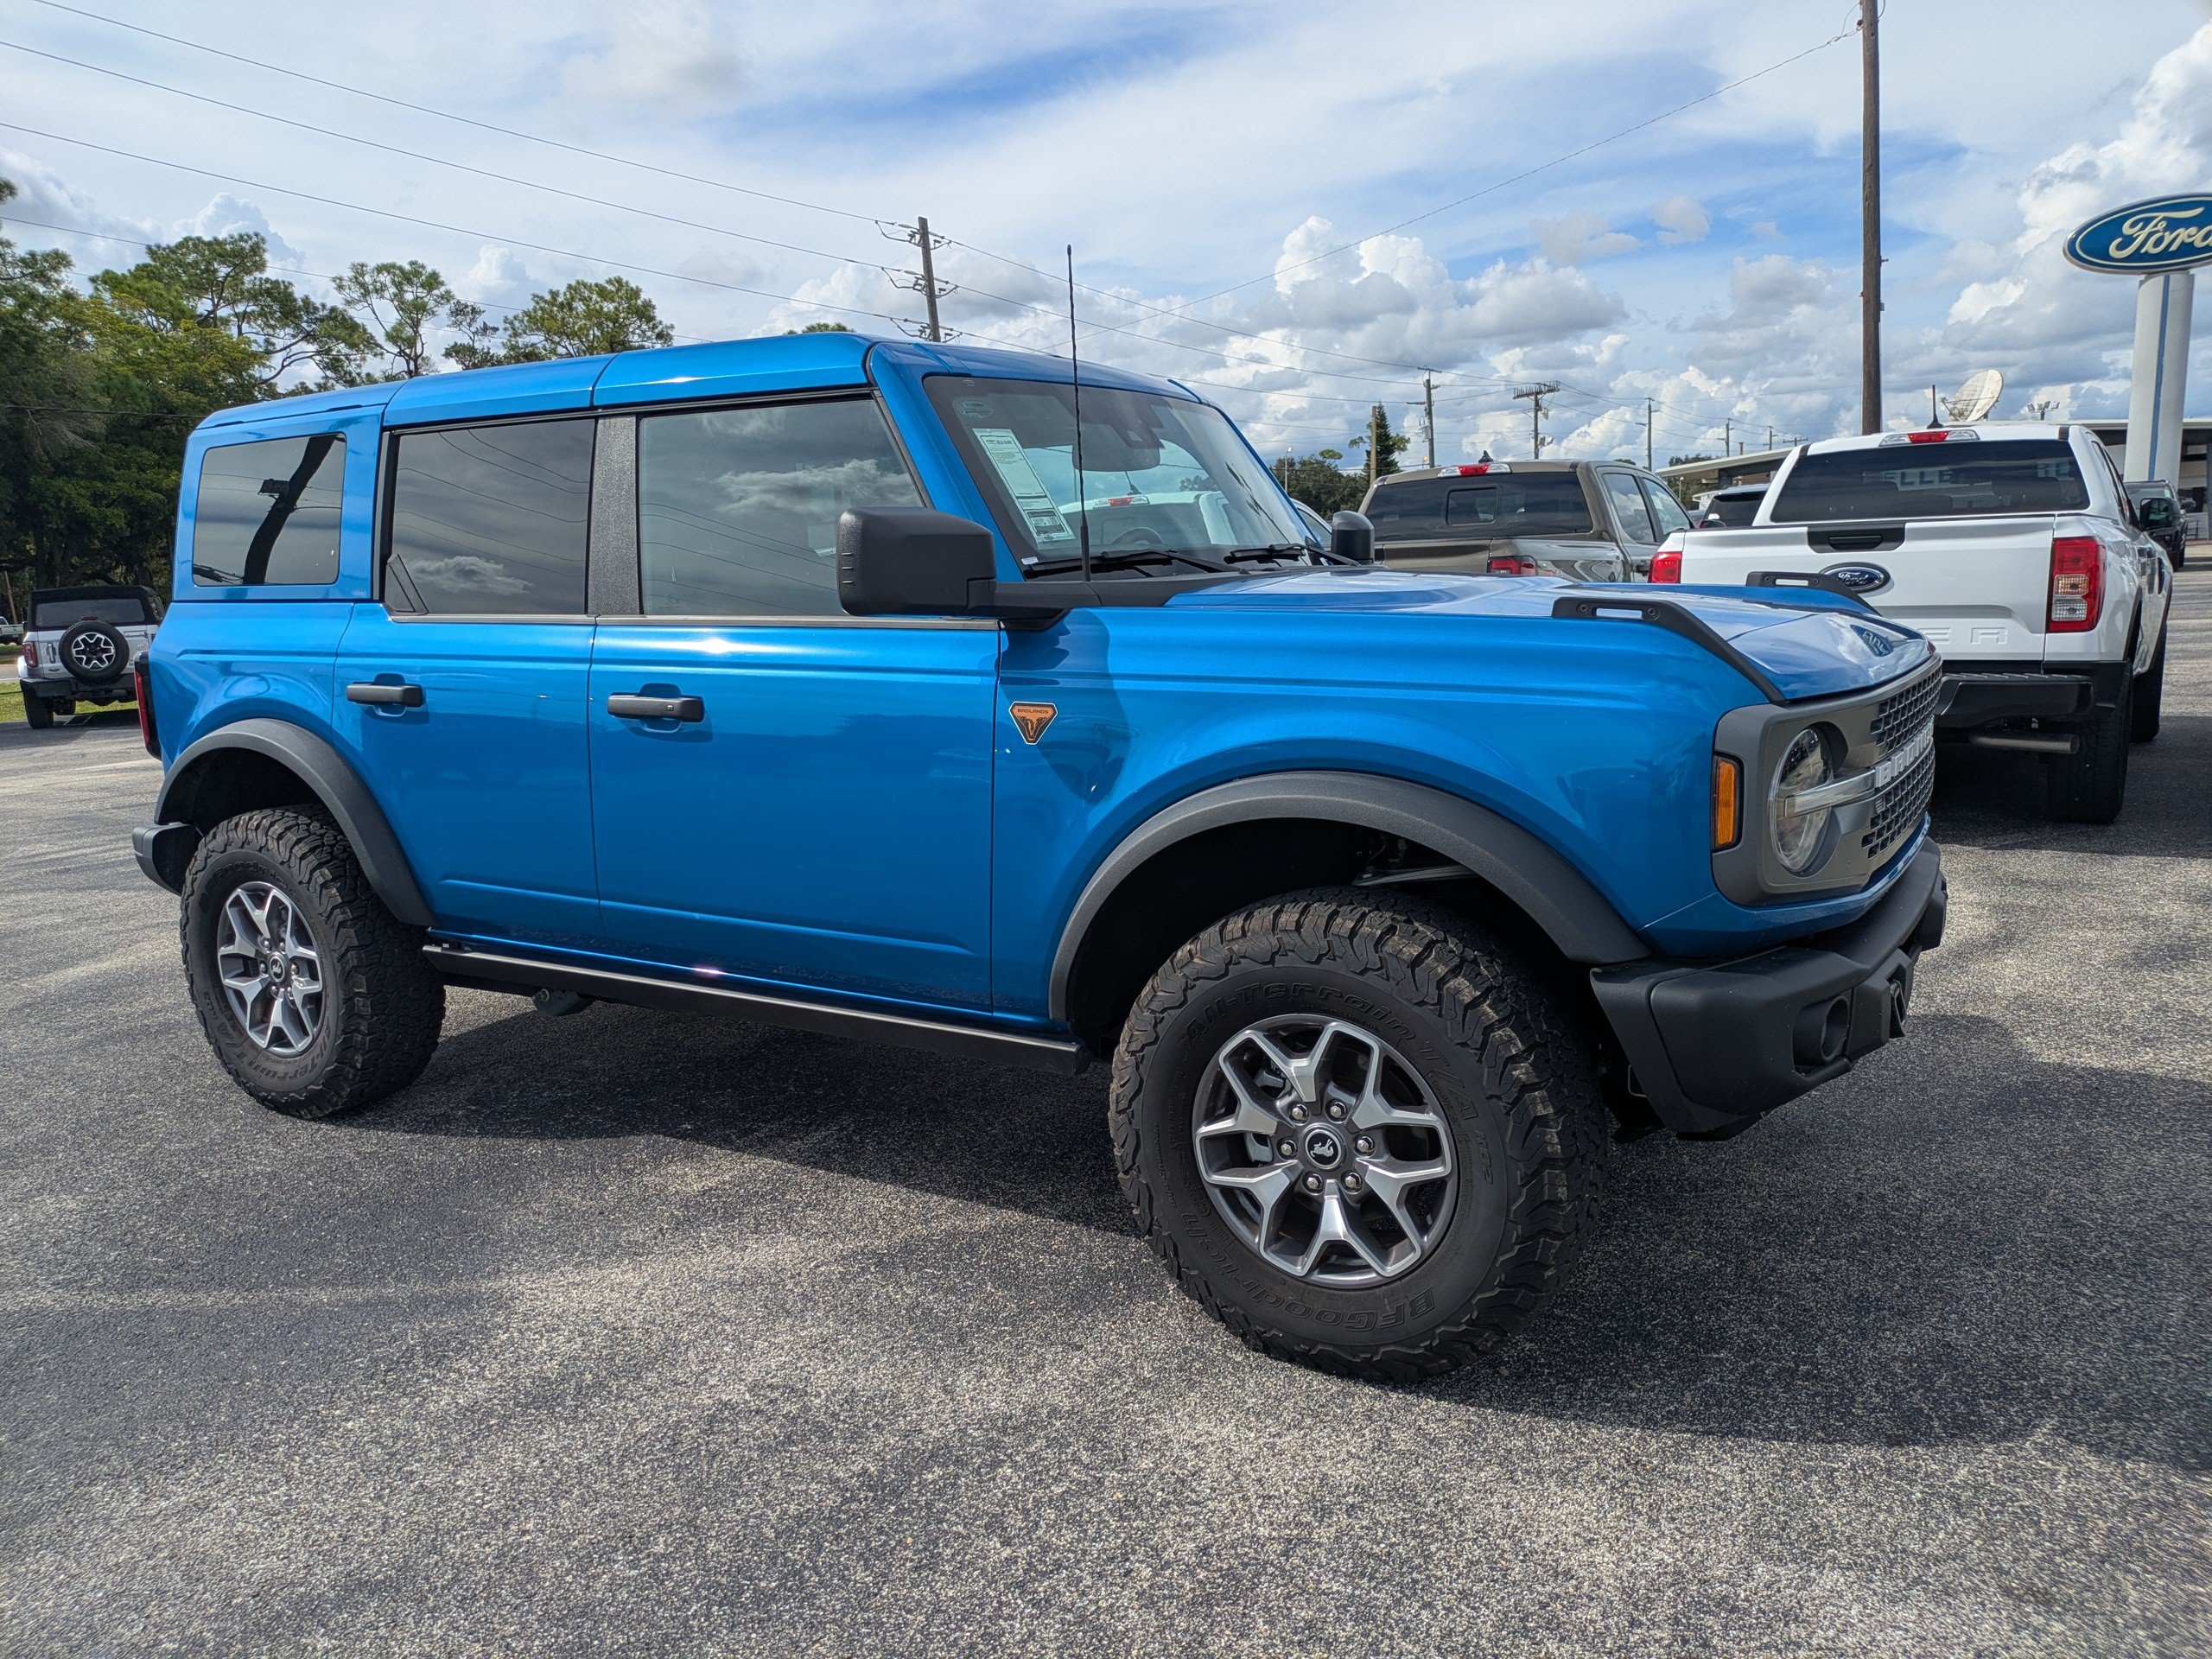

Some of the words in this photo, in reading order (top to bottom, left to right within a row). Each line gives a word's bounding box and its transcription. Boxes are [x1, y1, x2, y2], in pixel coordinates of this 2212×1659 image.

[1837, 571, 1870, 585] Ford
[1185, 981, 1417, 1048] All-Terrain
[1180, 1211, 1435, 1332] BFGoodrich
